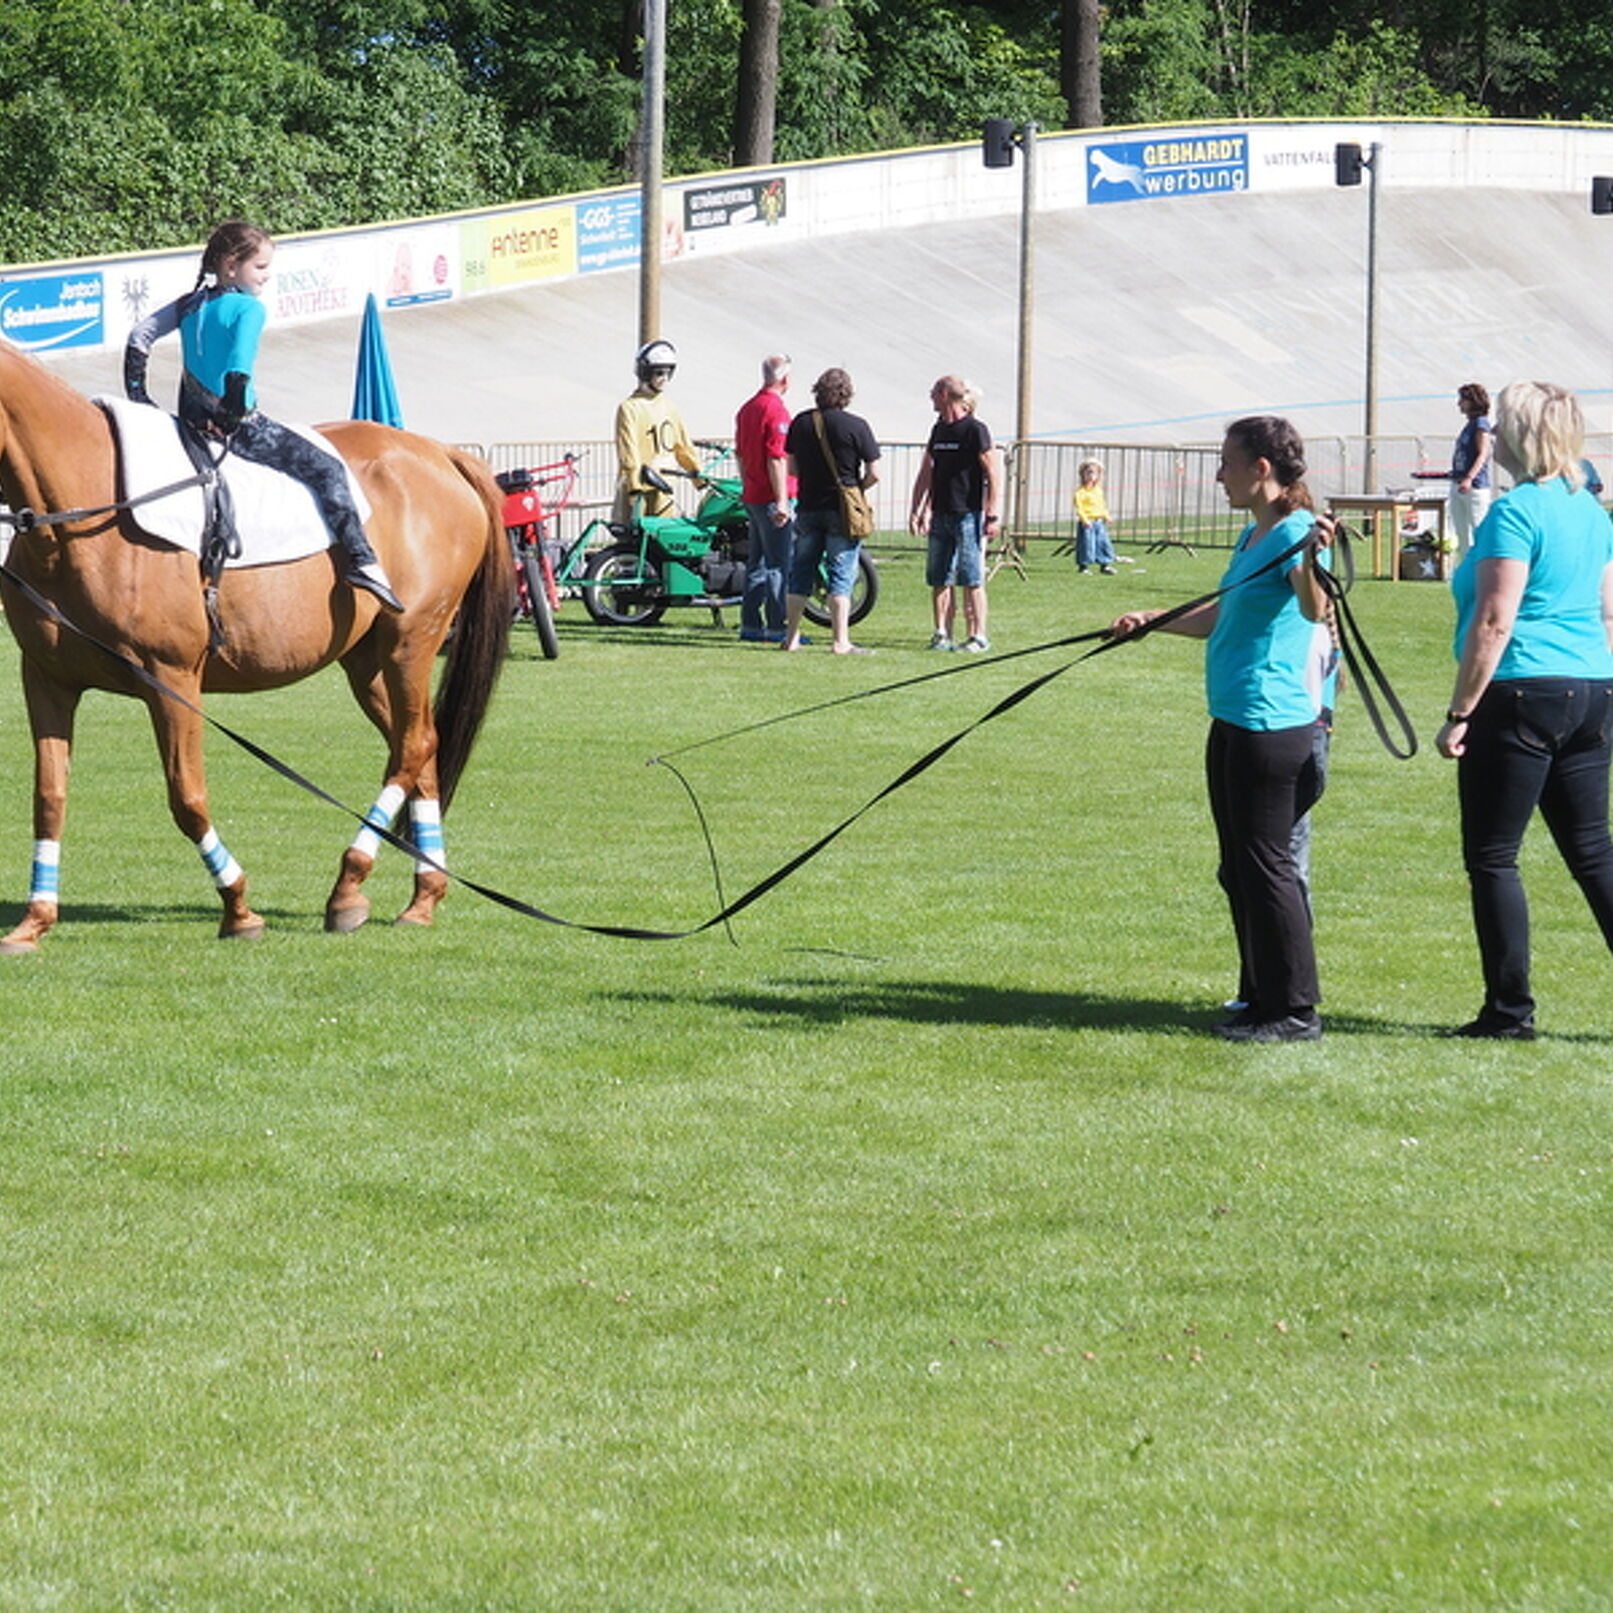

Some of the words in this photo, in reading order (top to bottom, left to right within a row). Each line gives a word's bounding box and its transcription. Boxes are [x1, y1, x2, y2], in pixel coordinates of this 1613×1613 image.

[1143, 139, 1244, 165] GEBHARDT
[1264, 150, 1337, 166] VATTENFAL
[1145, 168, 1245, 193] werbung
[492, 227, 558, 258] Antenne
[275, 287, 348, 318] APOTHEKE
[646, 419, 677, 454] 10
